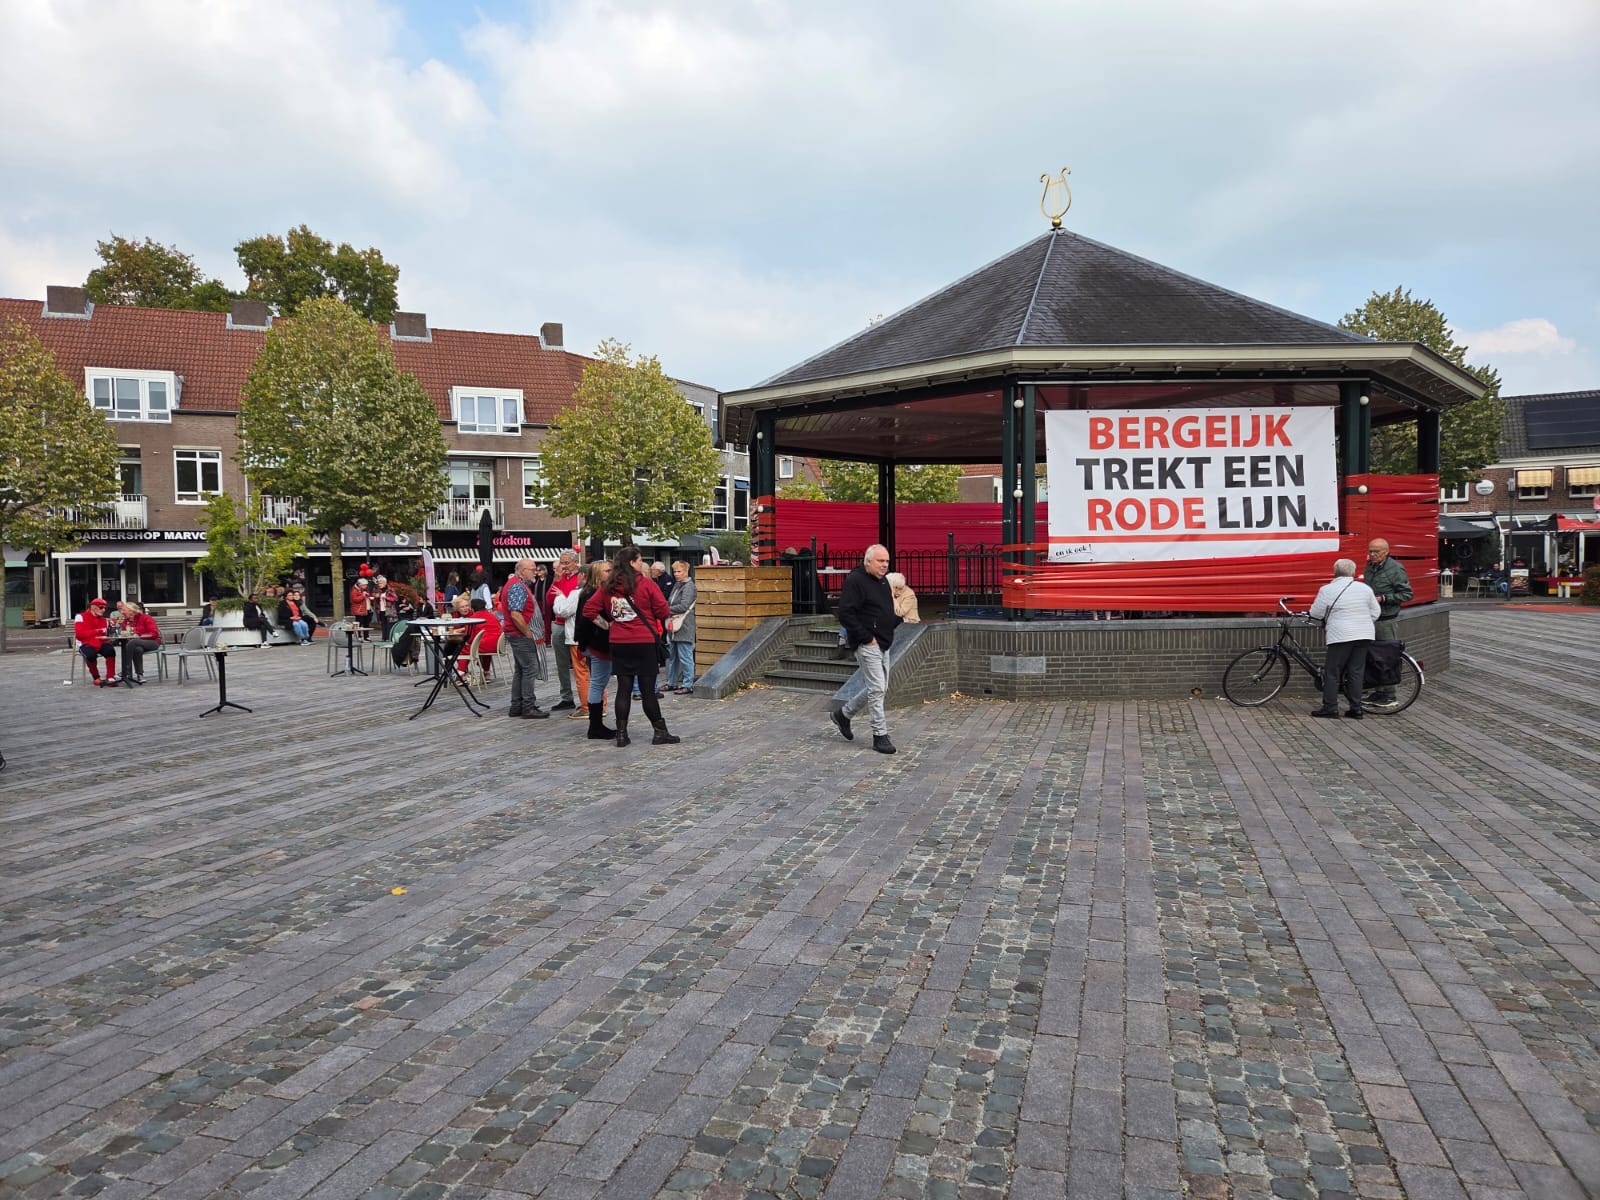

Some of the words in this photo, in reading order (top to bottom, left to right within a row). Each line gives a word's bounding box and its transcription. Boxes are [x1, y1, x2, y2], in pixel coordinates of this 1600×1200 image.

[1089, 414, 1293, 450] BERGEIJK
[1075, 456, 1212, 490] TREKT
[1223, 454, 1305, 488] EEN
[1087, 497, 1207, 531] RODE
[1217, 494, 1308, 529] LIJN
